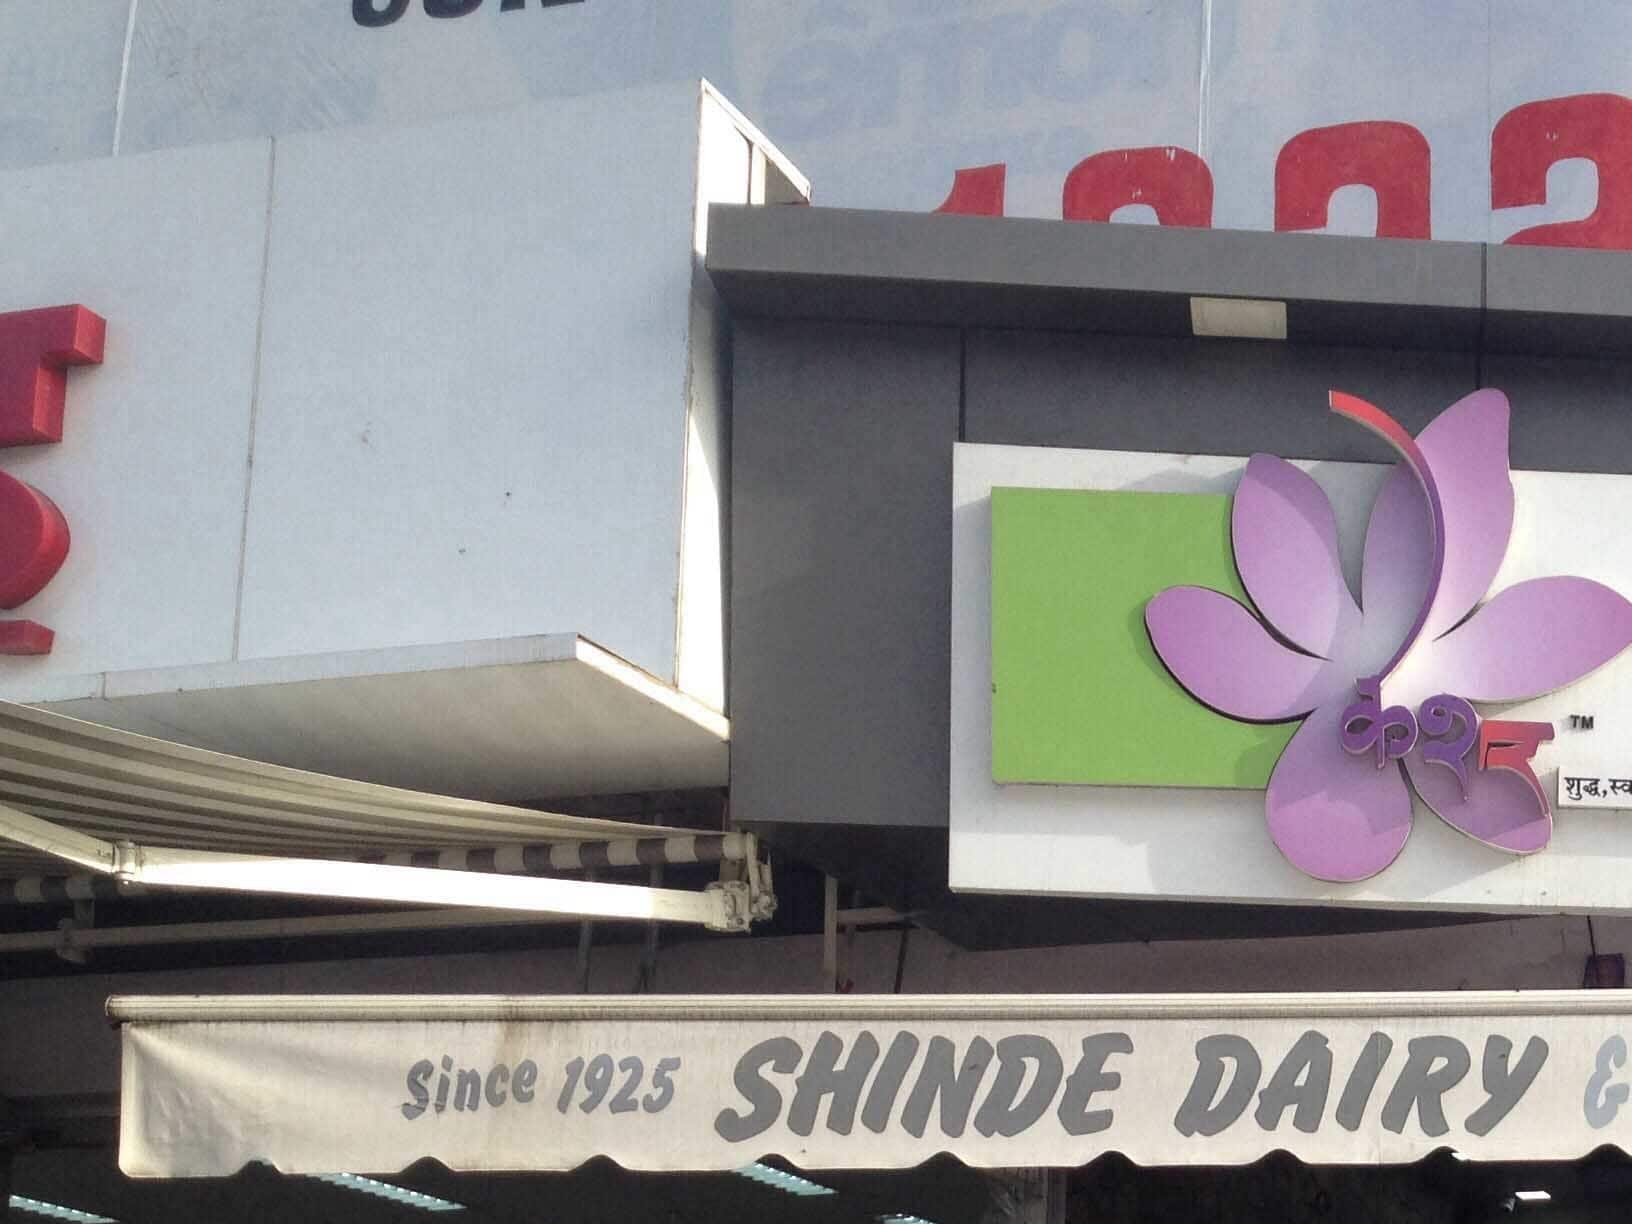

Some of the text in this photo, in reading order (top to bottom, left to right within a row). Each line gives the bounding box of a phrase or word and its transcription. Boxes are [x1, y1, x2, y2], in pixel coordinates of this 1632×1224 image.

[1570, 715, 1594, 729] TM
[400, 1054, 537, 1120] Since
[557, 1055, 681, 1116] 1925
[714, 1028, 1135, 1143] SHINDE
[1173, 1029, 1550, 1139] DAIRY
[1583, 1032, 1630, 1129] &
